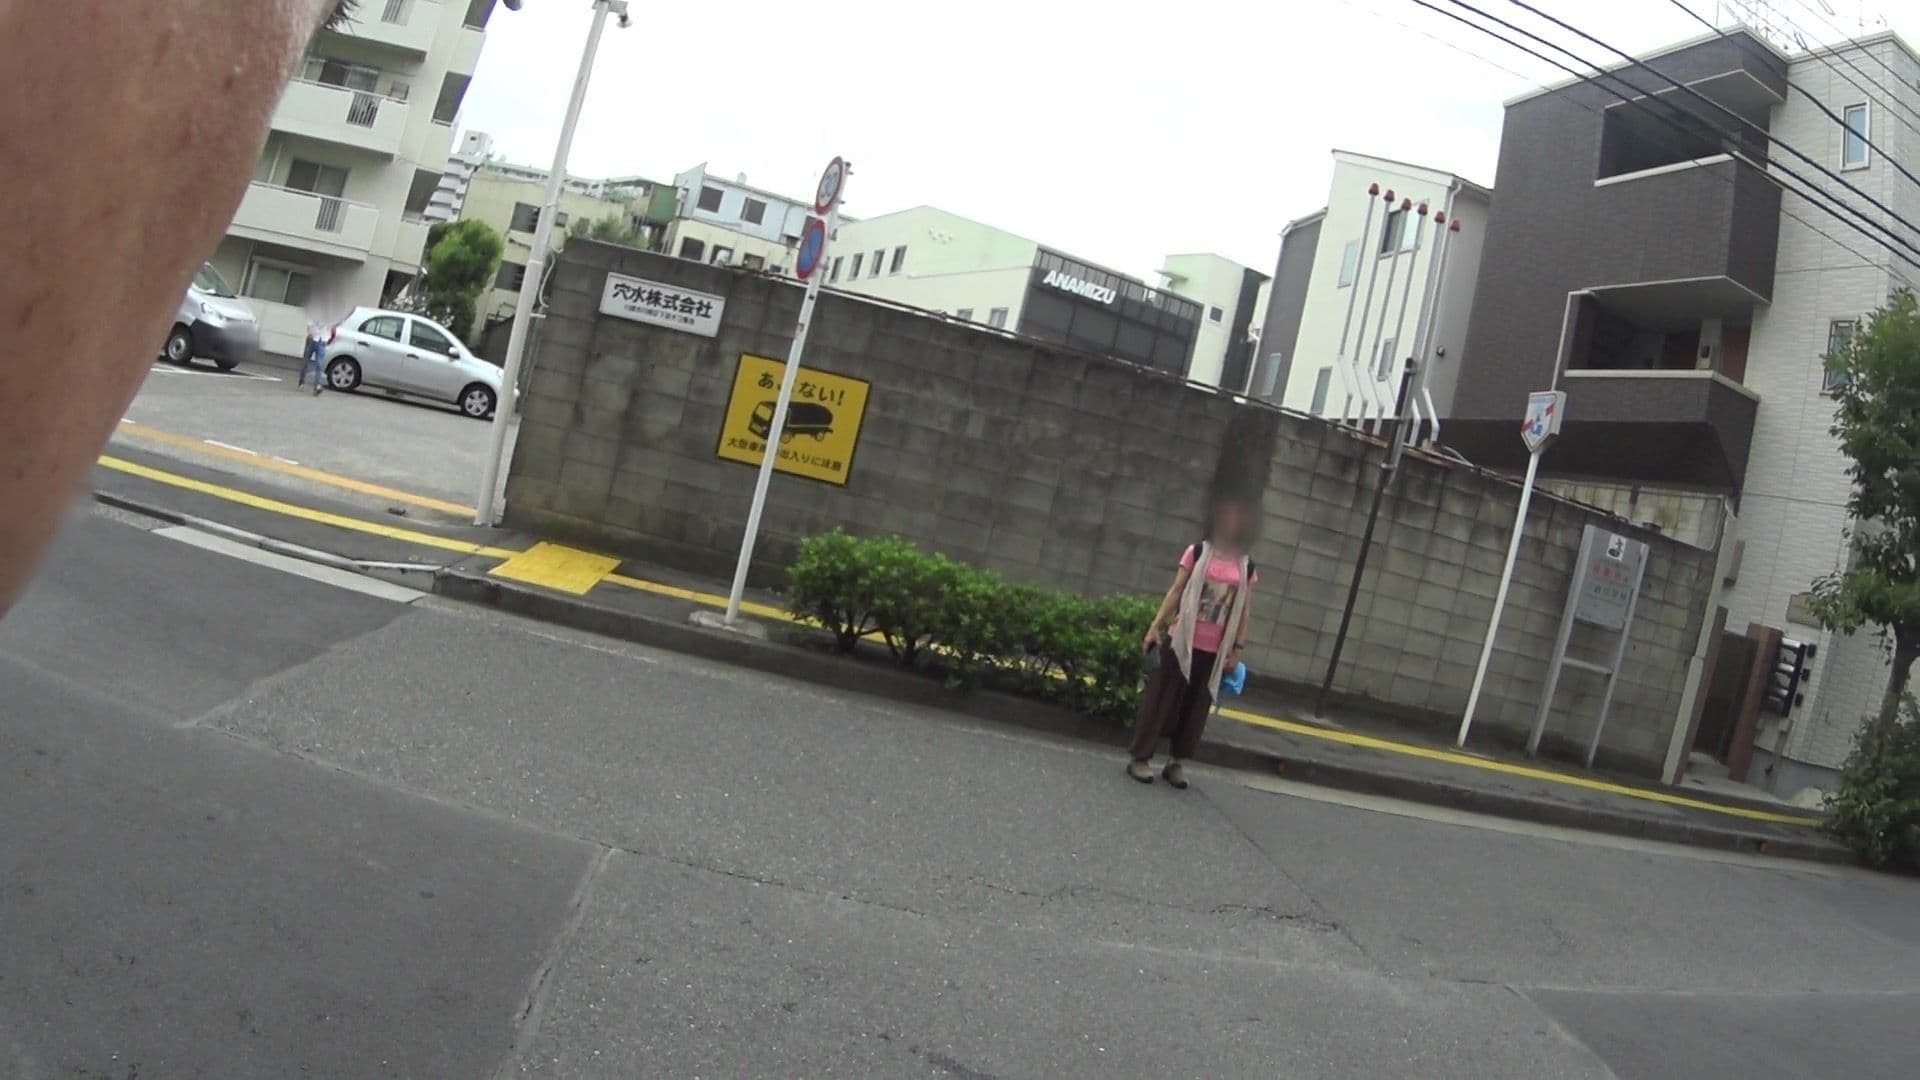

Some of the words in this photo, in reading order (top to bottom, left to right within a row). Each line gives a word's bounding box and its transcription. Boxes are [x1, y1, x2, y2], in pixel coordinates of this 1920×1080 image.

[612, 283, 713, 319] 穴水株式会社
[1043, 270, 1116, 305] ANAMIZU
[757, 371, 845, 406] あない!
